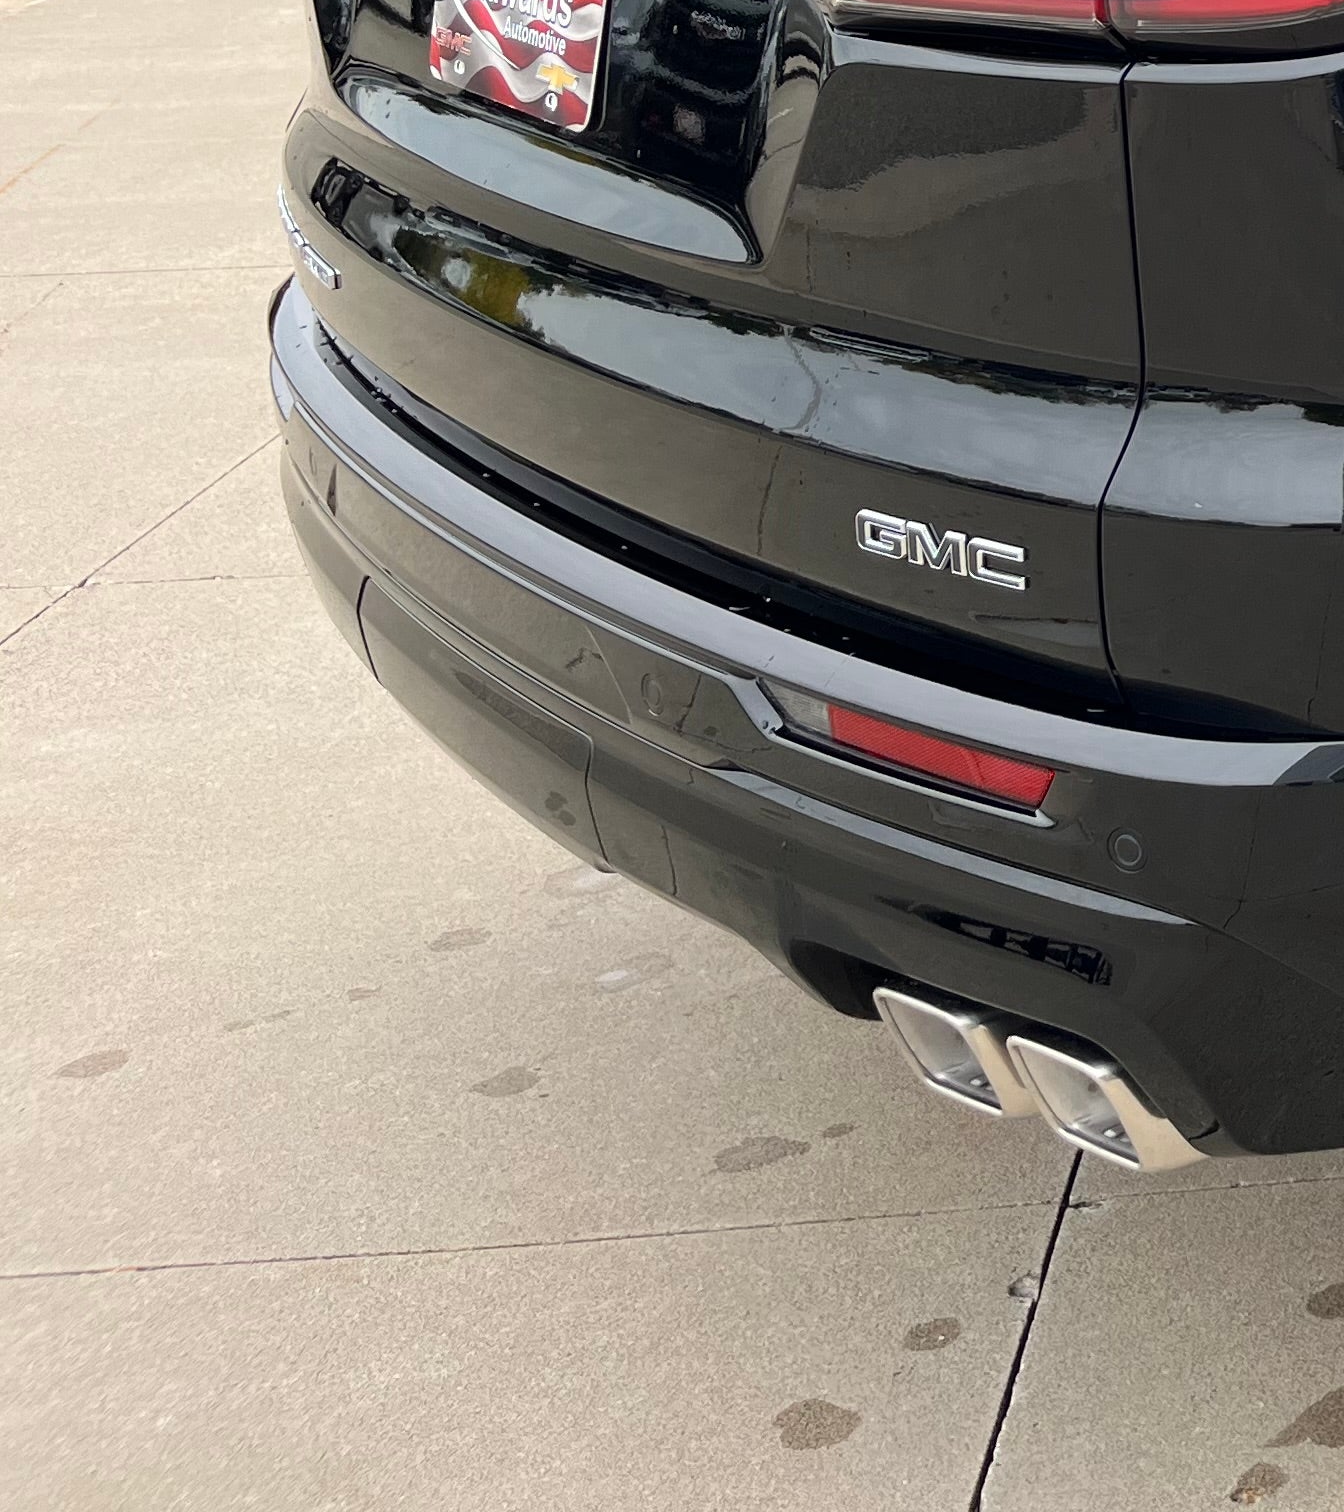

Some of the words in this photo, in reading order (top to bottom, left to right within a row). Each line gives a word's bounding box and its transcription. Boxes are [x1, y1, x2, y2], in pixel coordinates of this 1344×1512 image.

[434, 26, 472, 56] GMC
[503, 15, 567, 56] Automotive
[855, 508, 1028, 591] GMC
